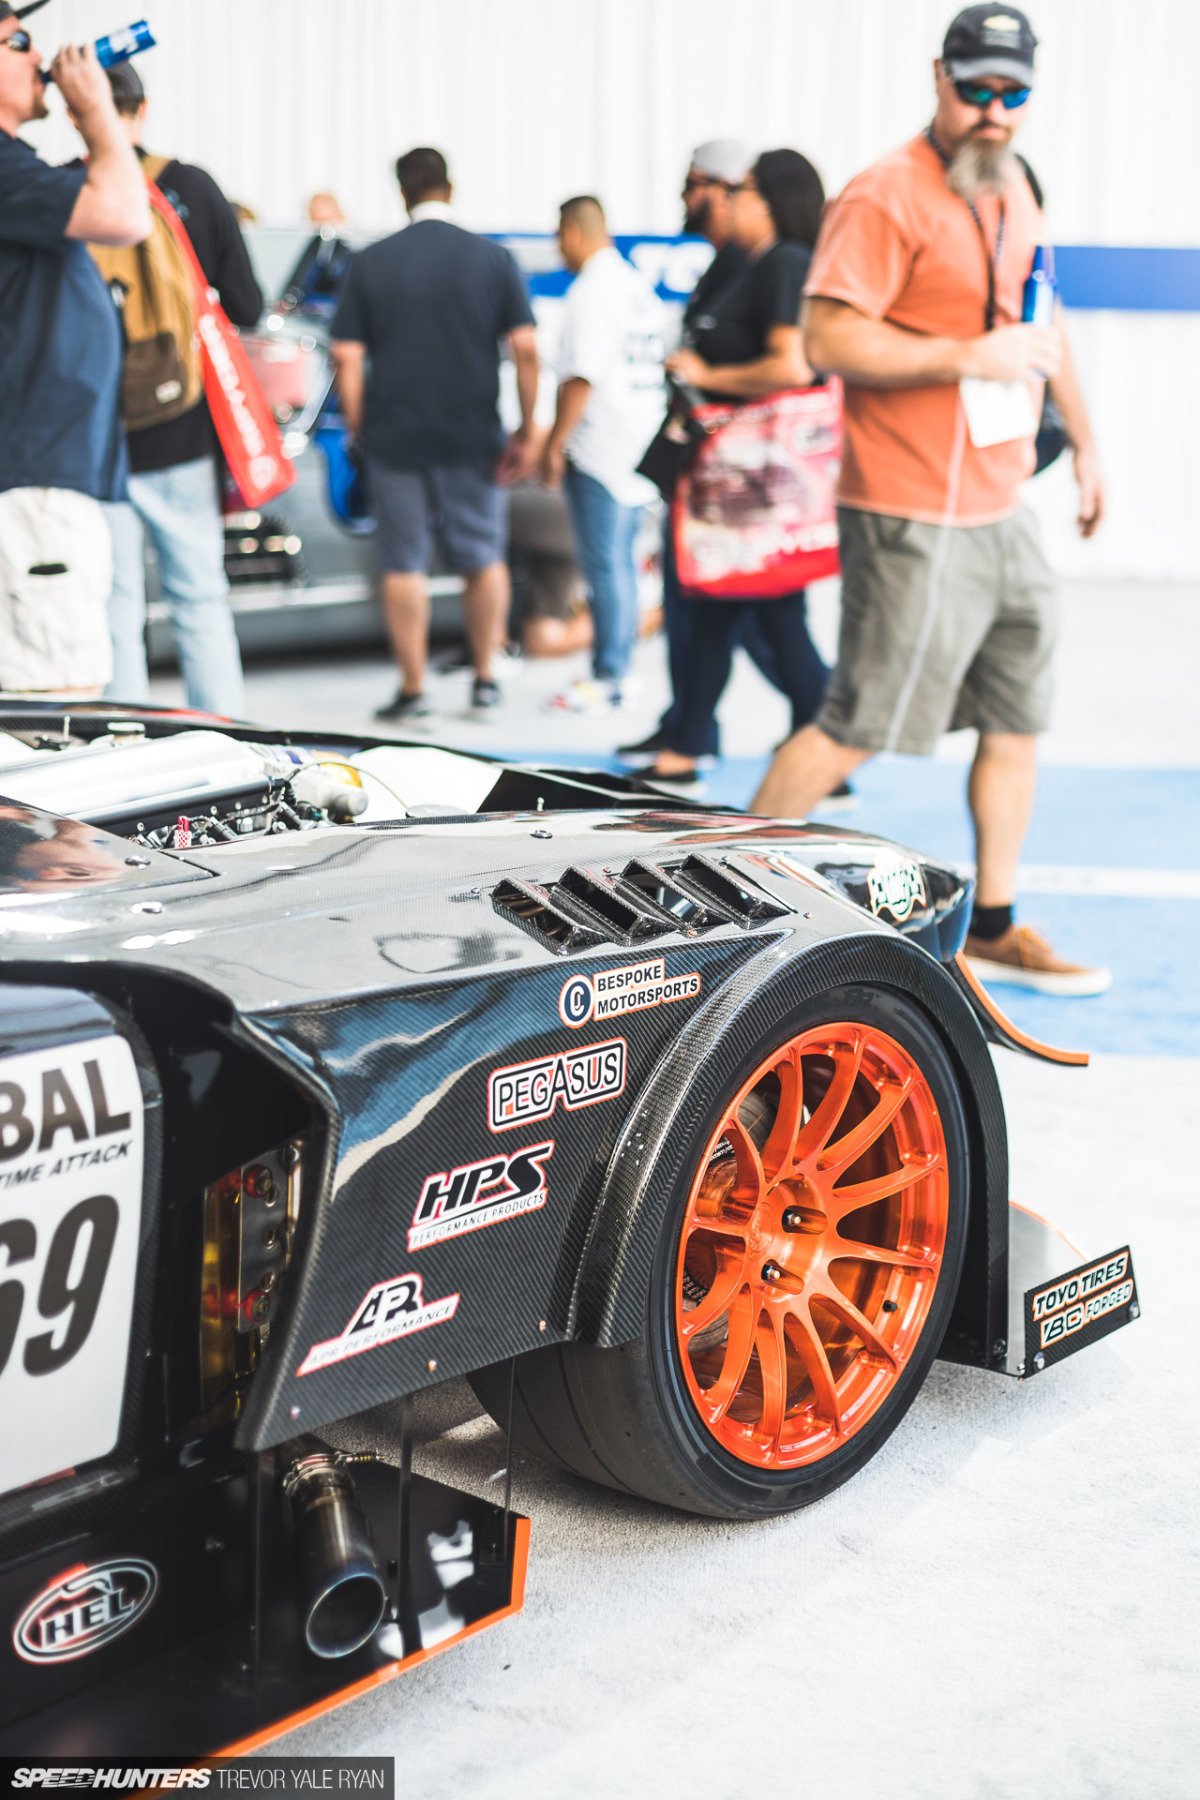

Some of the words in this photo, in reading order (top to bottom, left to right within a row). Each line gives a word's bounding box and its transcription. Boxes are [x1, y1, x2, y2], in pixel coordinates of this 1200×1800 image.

[597, 965, 662, 992] BESPOKE
[597, 978, 698, 1015] MOTORSPORTS
[499, 1052, 618, 1117] PEGASUS
[48, 1140, 133, 1176] ATTACK
[418, 1146, 551, 1221] HPS
[413, 1210, 488, 1244] PERFORMANCE
[491, 1193, 544, 1218] PRODUCTS
[1036, 1280, 1079, 1315] TOYO
[1082, 1257, 1125, 1292] TIRES
[1085, 1283, 1132, 1319] FORGED
[344, 1305, 454, 1351] PERFORMANCE
[43, 1588, 134, 1647] HEL
